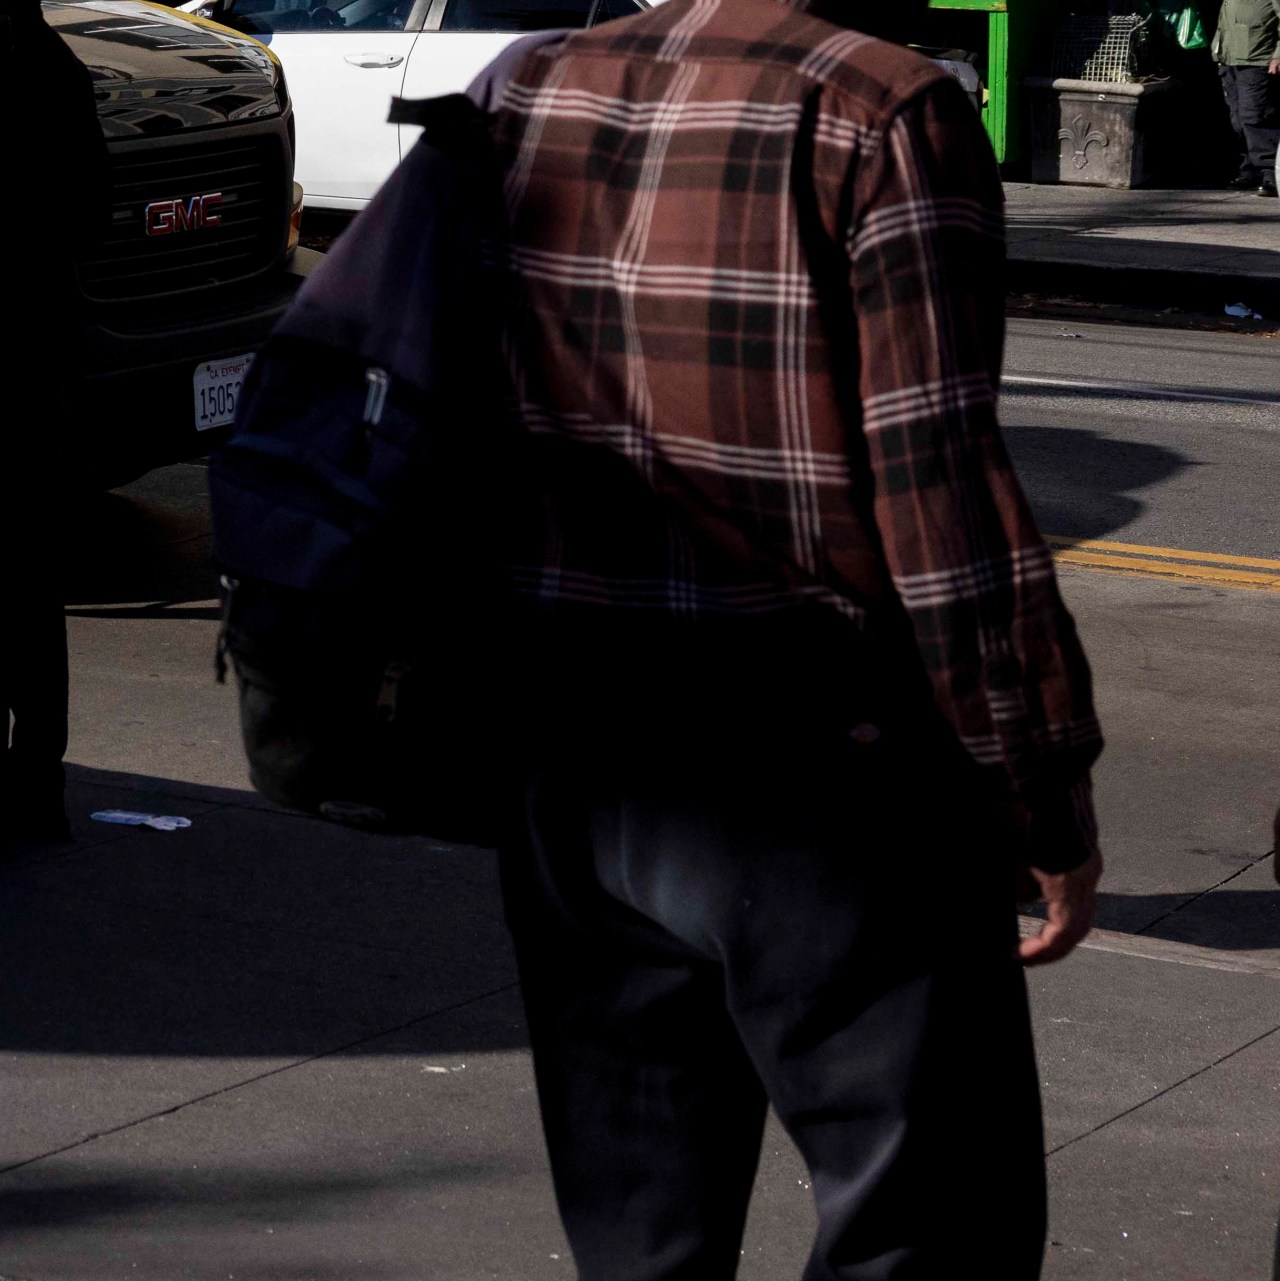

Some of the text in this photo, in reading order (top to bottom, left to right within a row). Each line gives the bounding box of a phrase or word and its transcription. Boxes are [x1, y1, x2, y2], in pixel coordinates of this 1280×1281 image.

[145, 192, 224, 236] GMC
[209, 363, 246, 380] CA EXEMPT
